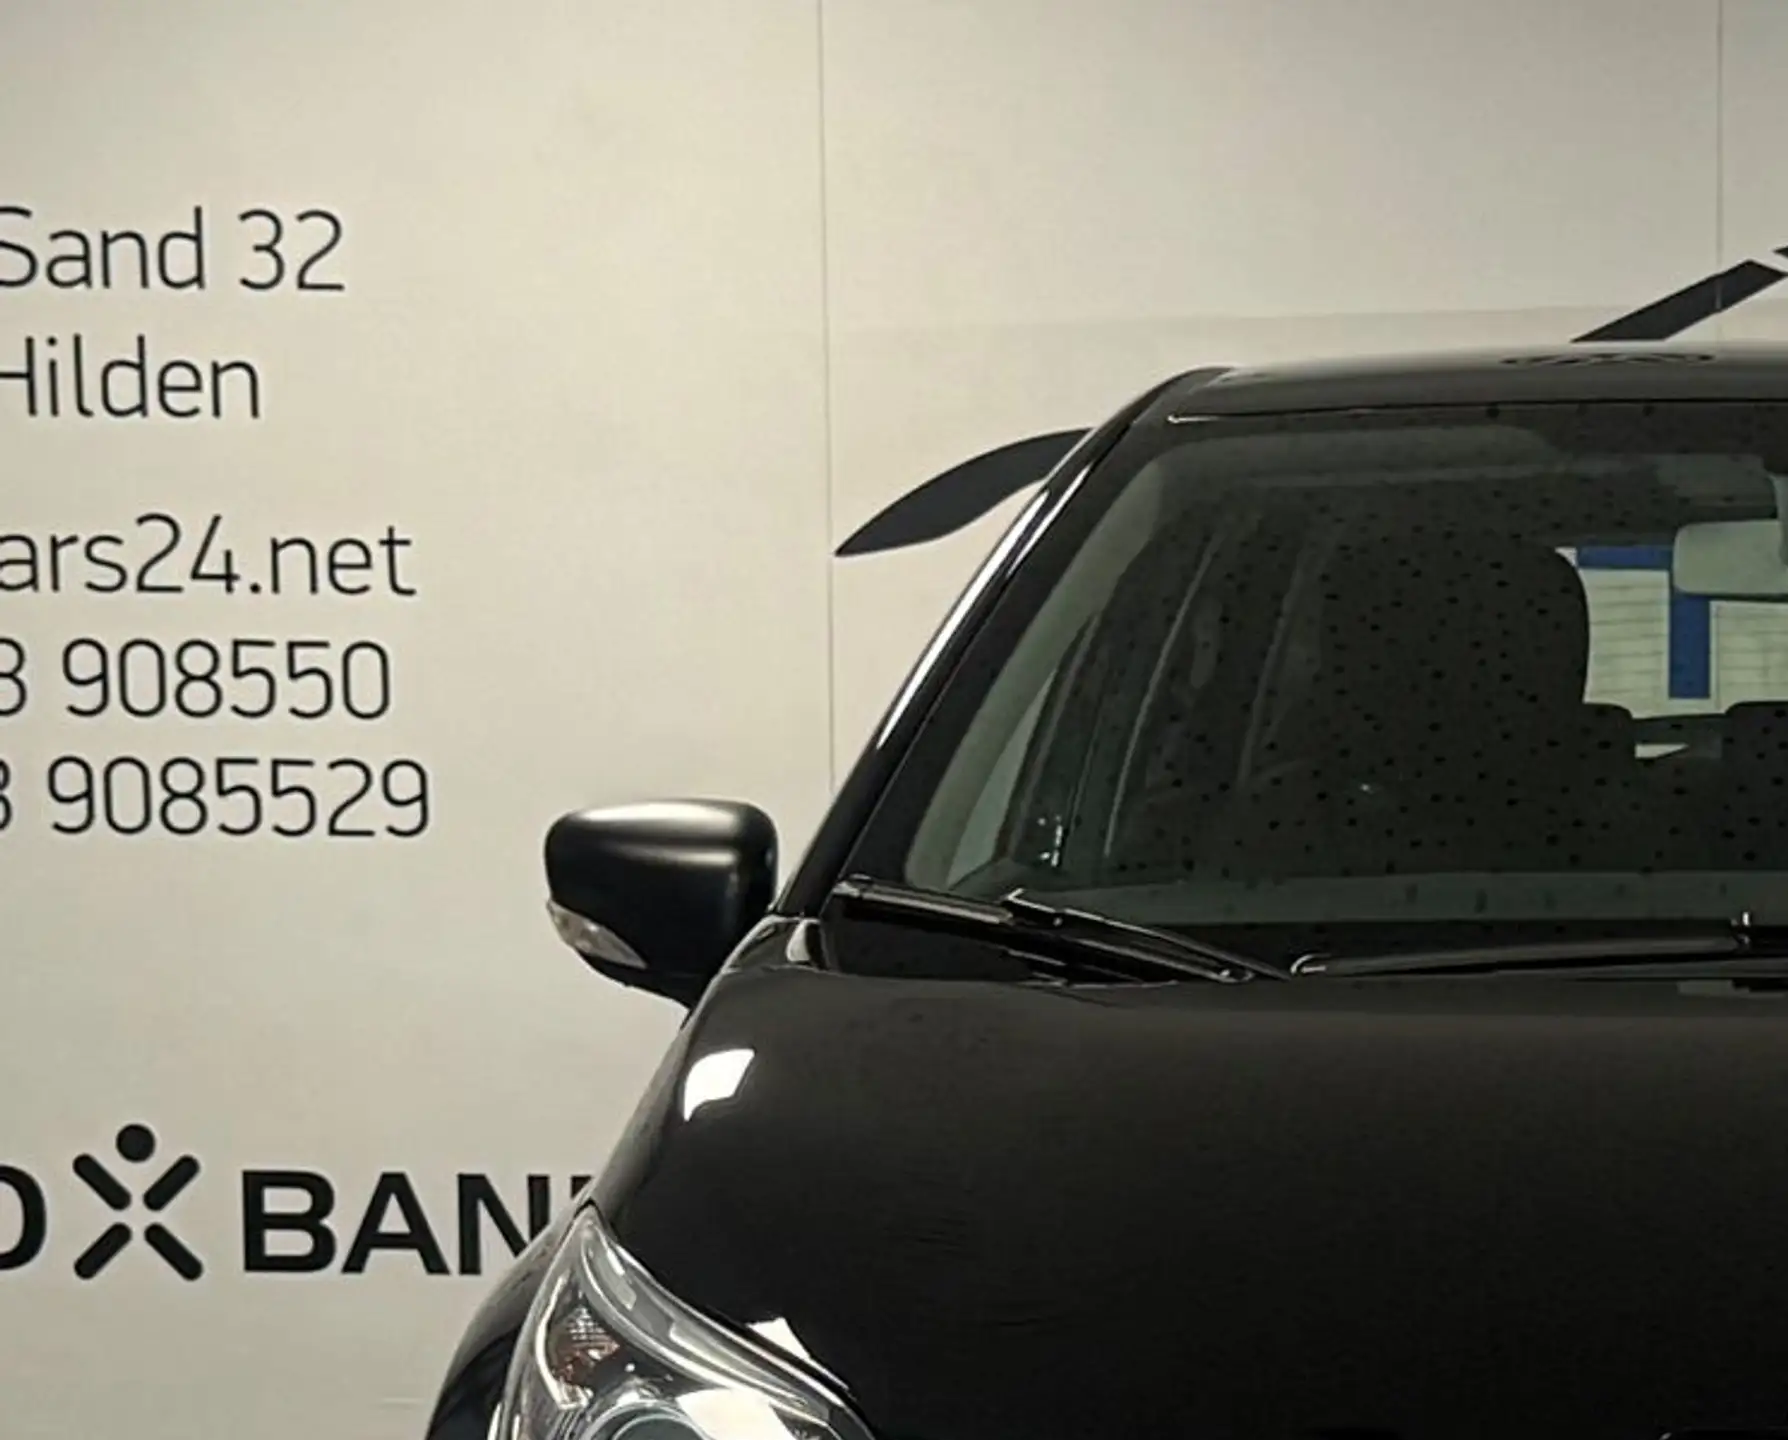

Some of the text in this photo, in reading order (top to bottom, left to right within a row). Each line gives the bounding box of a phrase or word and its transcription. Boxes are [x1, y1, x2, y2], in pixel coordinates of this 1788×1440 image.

[0, 207, 345, 291] Sand 32
[62, 638, 391, 720] 908550
[47, 755, 429, 838] 9085529
[242, 1169, 596, 1276] BAN
